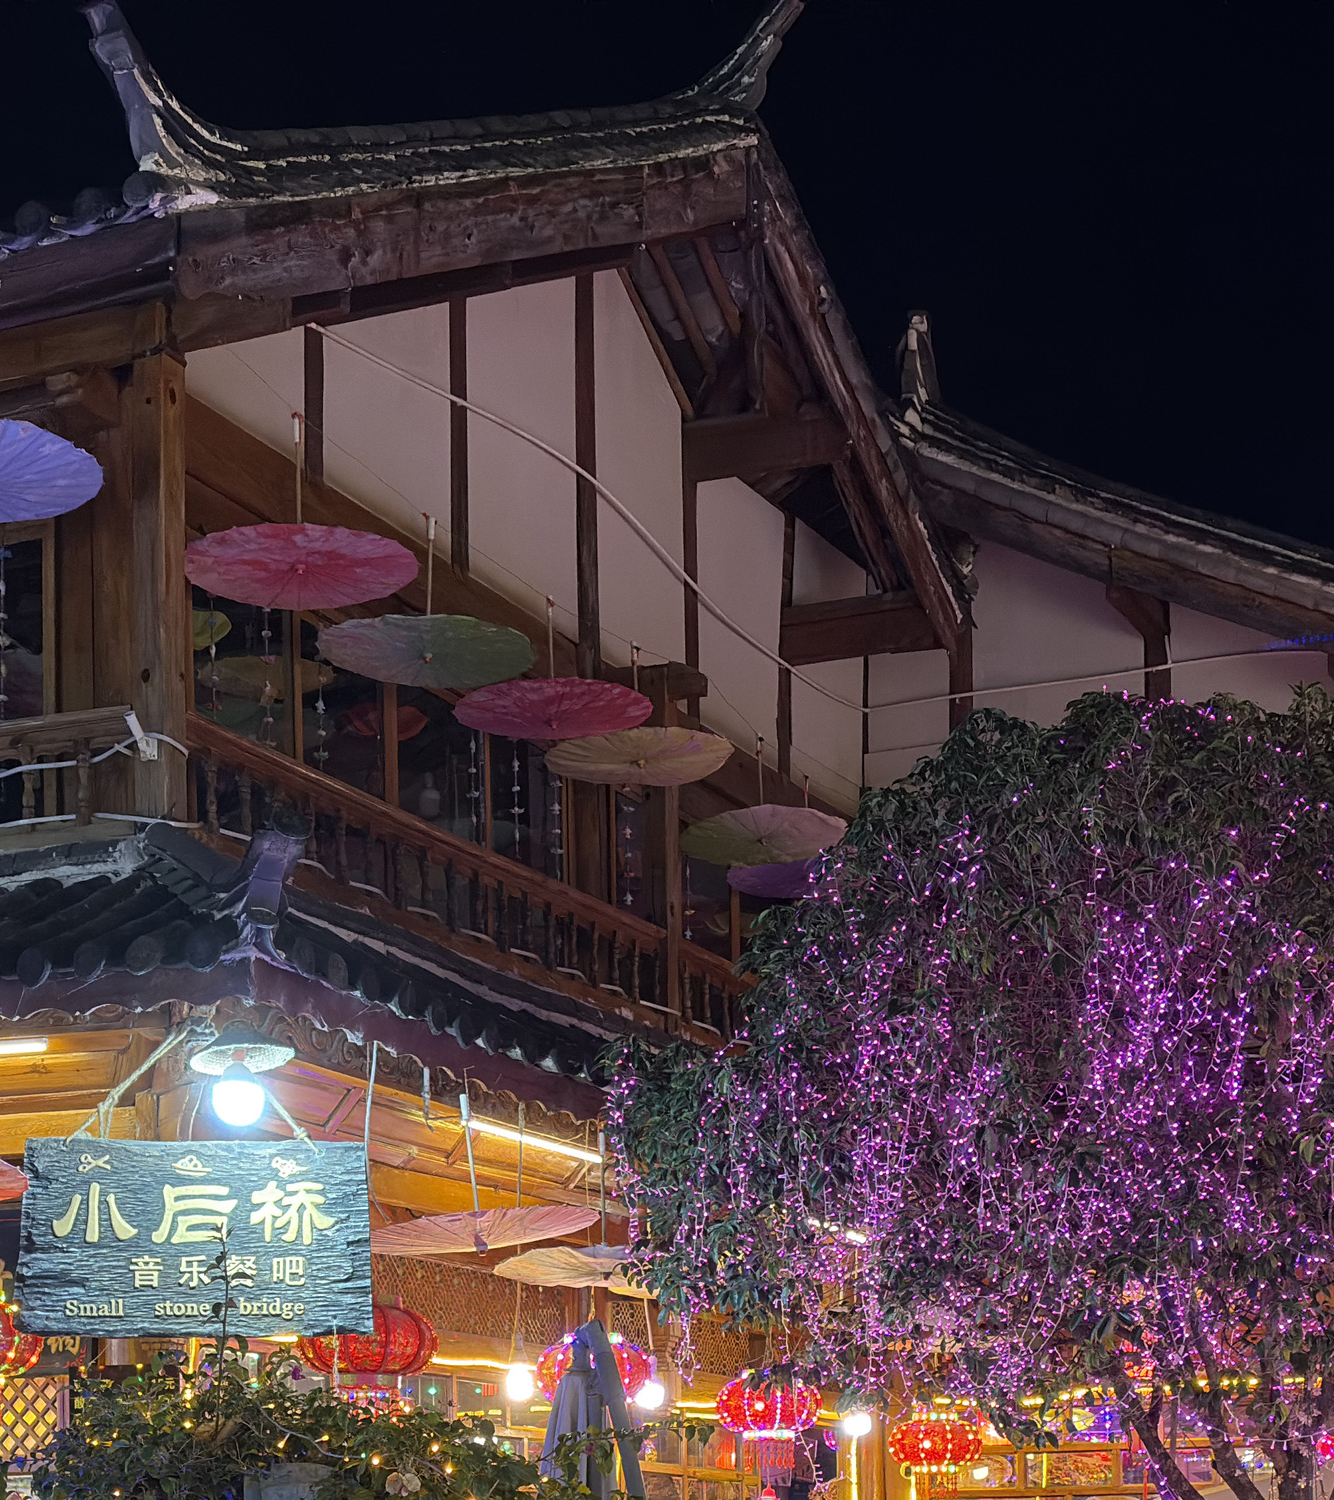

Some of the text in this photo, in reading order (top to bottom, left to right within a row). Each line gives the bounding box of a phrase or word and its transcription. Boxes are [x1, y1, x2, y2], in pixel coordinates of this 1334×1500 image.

[129, 1255, 306, 1290] 音乐餐吧
[65, 1298, 305, 1320] Small stone bridge
